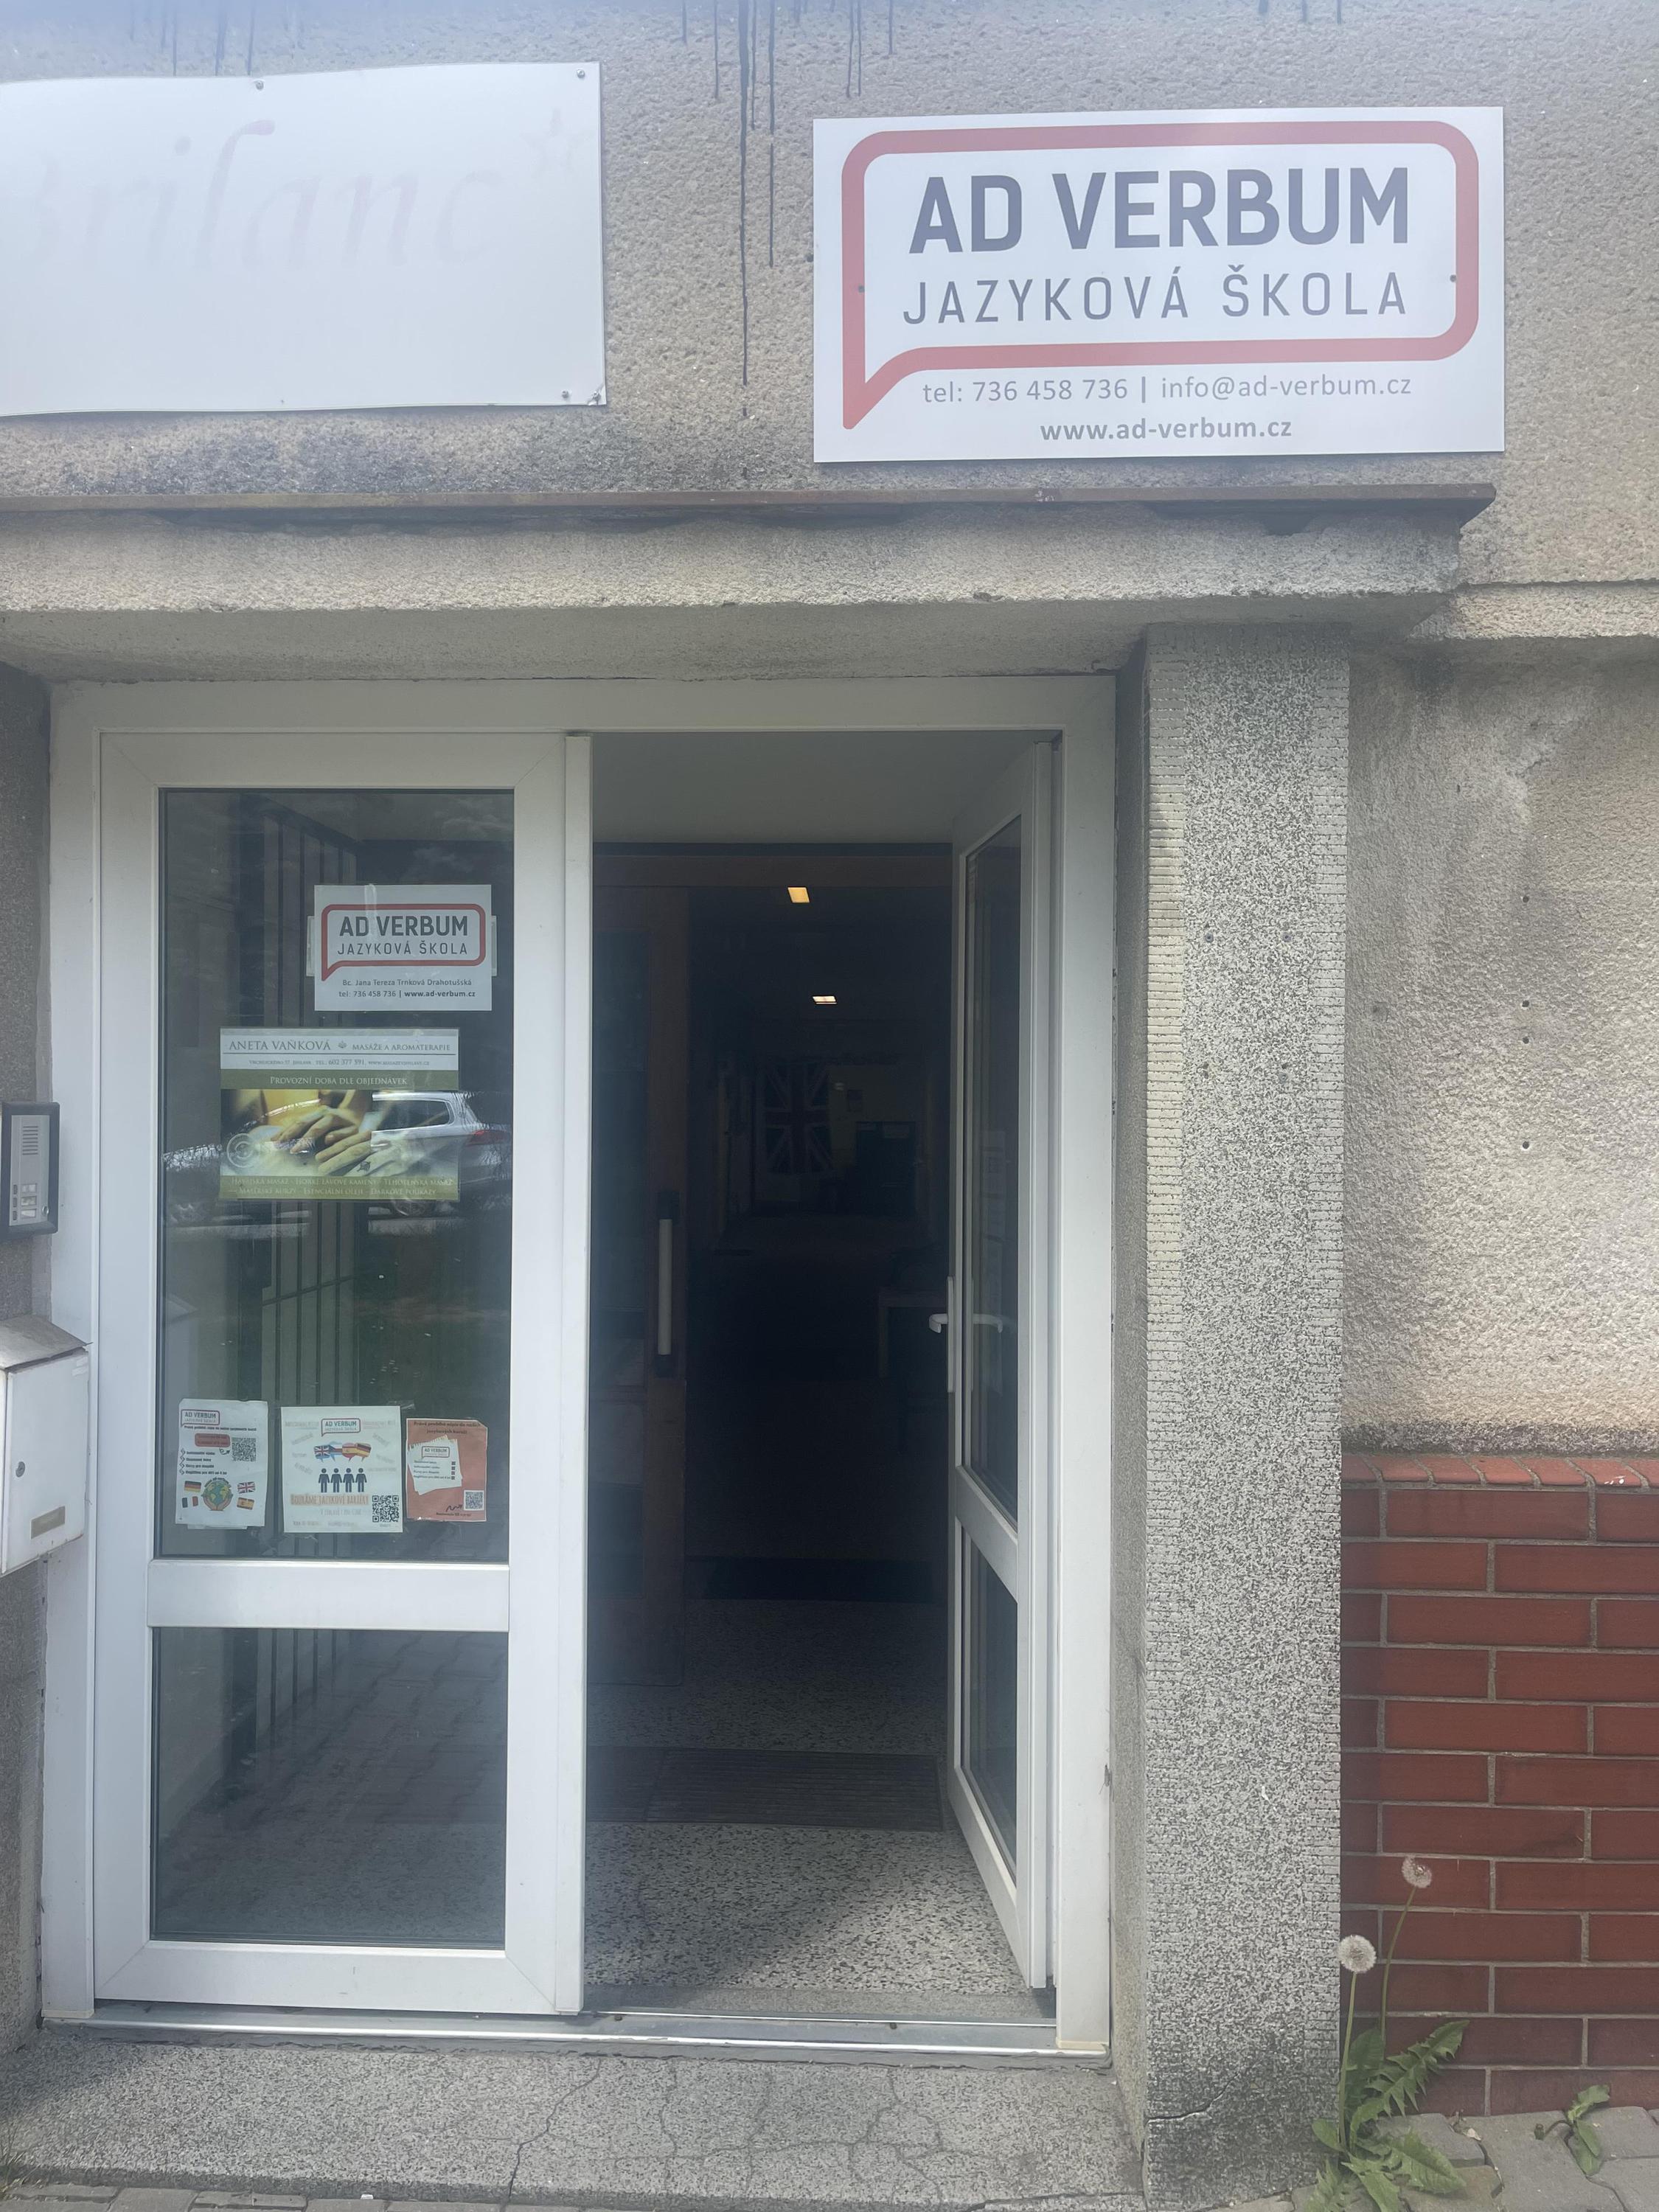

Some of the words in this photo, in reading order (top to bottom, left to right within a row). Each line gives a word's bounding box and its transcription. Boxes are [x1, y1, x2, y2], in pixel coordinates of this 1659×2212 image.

[908, 175, 1023, 254] AD
[1052, 167, 1409, 250] VERBUM
[902, 265, 1189, 325] JAZYKOVÁ
[1222, 263, 1407, 317] ŠKOLA
[922, 378, 964, 403] tel:
[973, 378, 1018, 403] 736
[1026, 378, 1073, 402] 458
[1082, 376, 1128, 401] 736
[1161, 374, 1412, 400] info@ad-verbum.cz
[1040, 416, 1293, 443] www.ad-verbum.cz
[339, 916, 369, 936] AD
[377, 915, 468, 936] VERBUM
[338, 940, 411, 955] JAZYKOVÁ
[419, 940, 467, 955] ŠKOLA
[229, 1040, 269, 1051] ANETA
[272, 1038, 331, 1051] VAŇKOVÁ
[352, 1042, 383, 1051] MASÁŽE
[315, 1077, 338, 1085] DOBA
[339, 1077, 354, 1085] DLE
